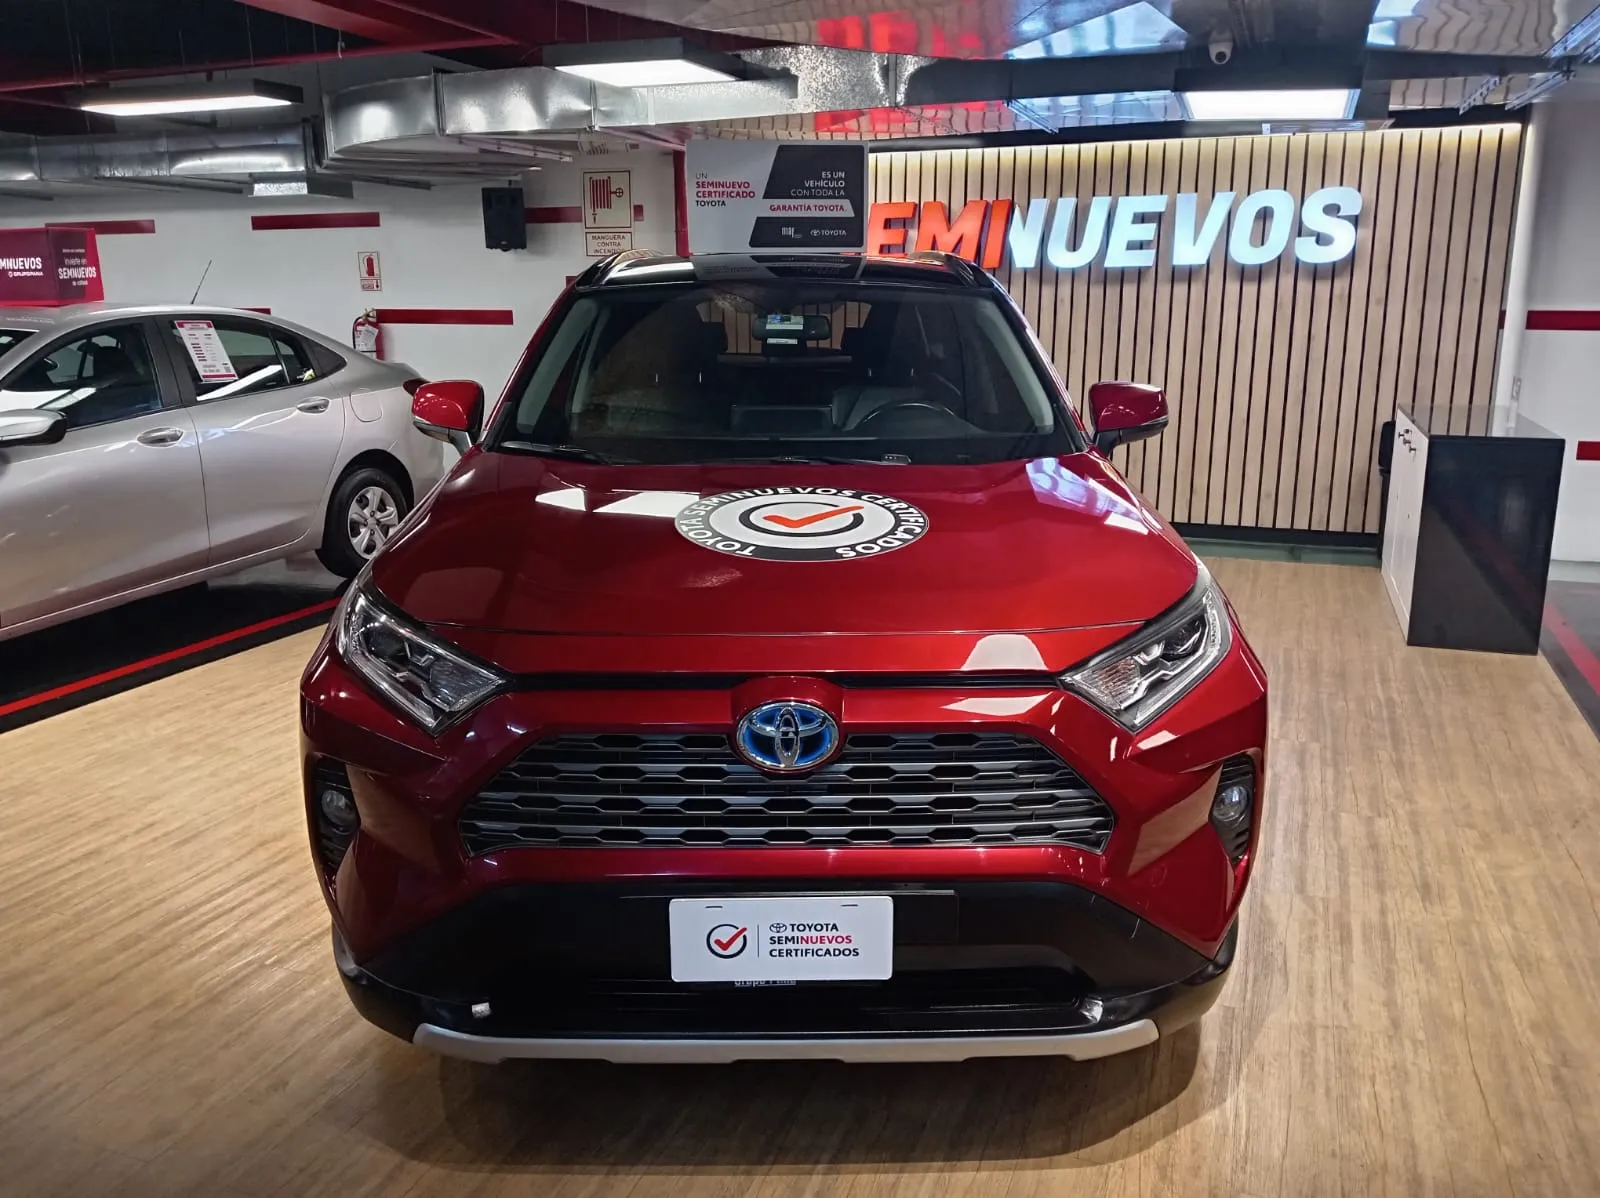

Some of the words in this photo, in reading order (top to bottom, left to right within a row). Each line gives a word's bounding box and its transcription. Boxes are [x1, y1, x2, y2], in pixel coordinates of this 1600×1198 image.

[696, 172, 708, 180] UN
[822, 171, 832, 179] ES
[833, 171, 845, 179] UN
[696, 181, 751, 189] SEMINUEVO
[804, 179, 845, 188] VEHÍCULO
[696, 190, 756, 199] CERTIFICADO
[790, 189, 811, 197] CON
[811, 189, 834, 197] TODA
[835, 189, 845, 197] LA
[696, 200, 727, 208] TOYOTA
[769, 203, 812, 212] GARANTÍA
[866, 186, 1363, 270] EMINUEVOS
[684, 487, 857, 516] SEMINUEVOS
[835, 494, 925, 558] CERTIFICADOS
[680, 518, 757, 556] TOYOTA
[789, 923, 839, 933] TOYOTA
[769, 935, 853, 945] SEMINUEVOS
[769, 947, 860, 958] CERTIFICADOS
